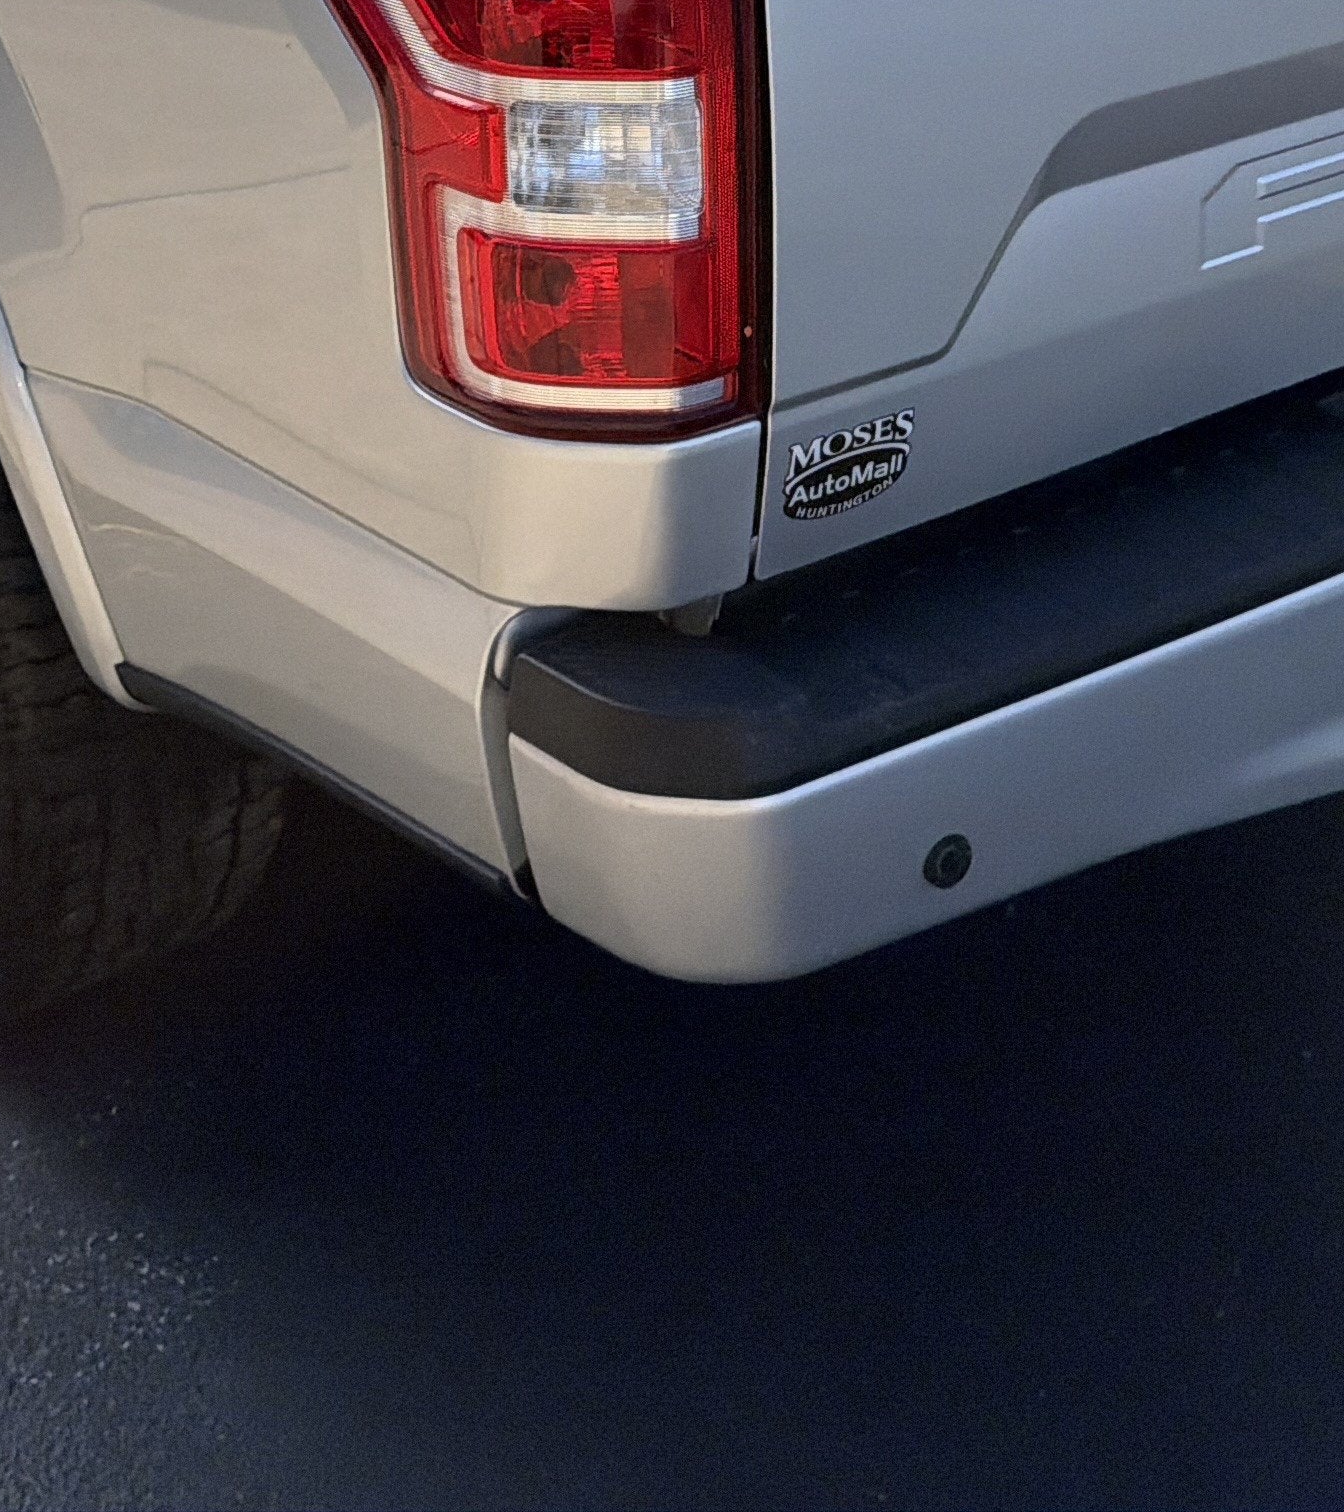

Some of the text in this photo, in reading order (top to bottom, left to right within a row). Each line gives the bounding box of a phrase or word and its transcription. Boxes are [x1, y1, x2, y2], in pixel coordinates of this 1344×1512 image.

[785, 408, 915, 482] MOSES
[788, 452, 904, 508] AutoMall
[795, 475, 894, 519] HUNTINGTON
